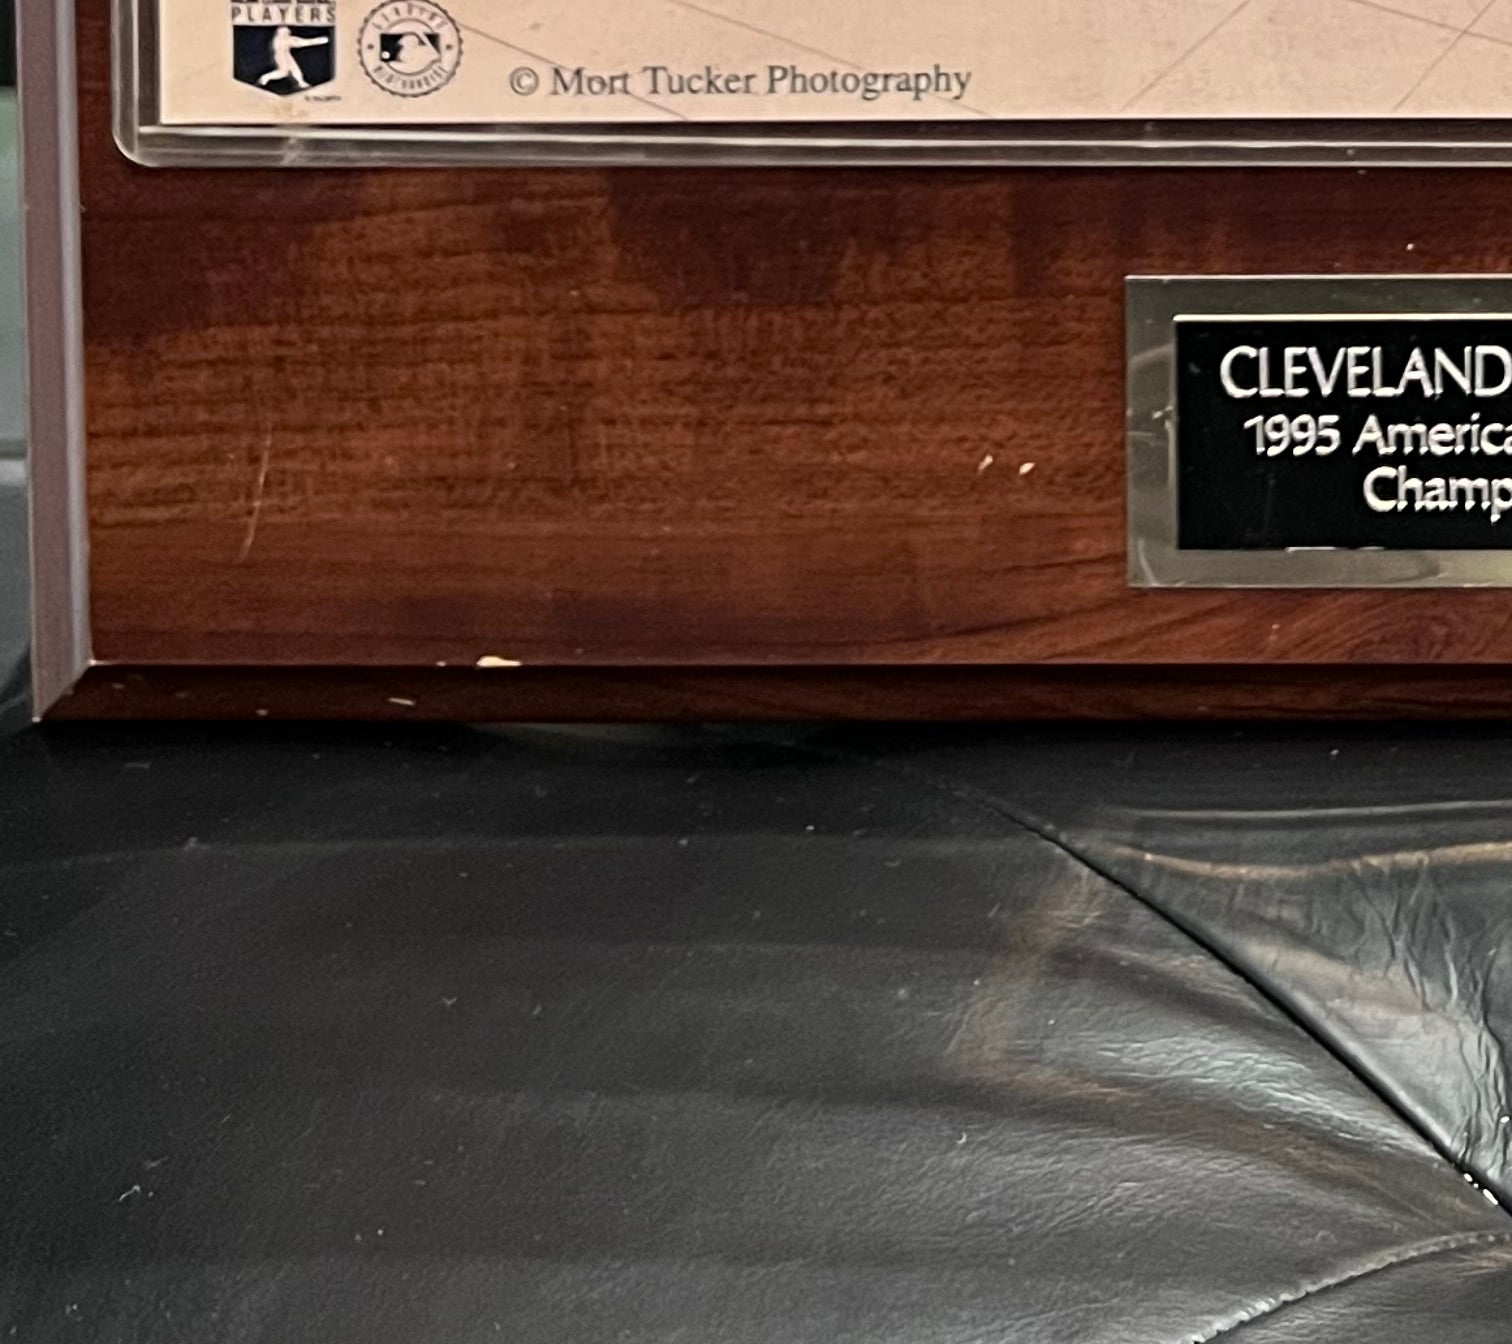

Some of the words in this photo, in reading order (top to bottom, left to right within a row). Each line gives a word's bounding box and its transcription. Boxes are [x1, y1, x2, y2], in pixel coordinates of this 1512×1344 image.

[231, 7, 336, 23] PLAYERS
[551, 67, 632, 97] Mort
[642, 66, 756, 97] Tucker
[766, 64, 973, 103] Photography
[1243, 414, 1341, 456] 1995
